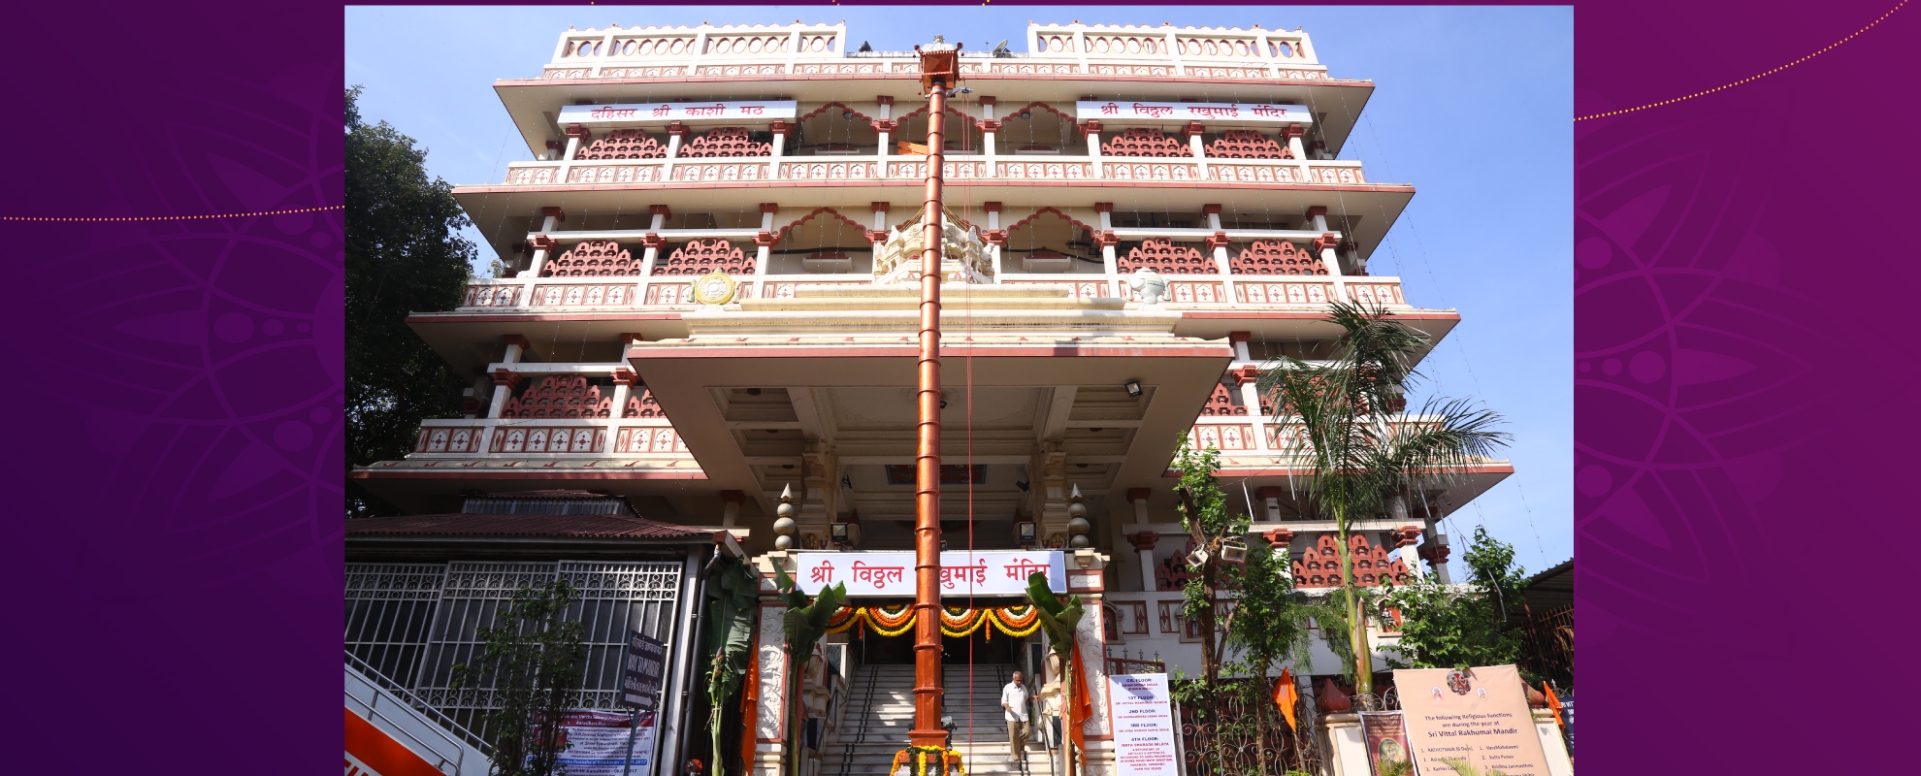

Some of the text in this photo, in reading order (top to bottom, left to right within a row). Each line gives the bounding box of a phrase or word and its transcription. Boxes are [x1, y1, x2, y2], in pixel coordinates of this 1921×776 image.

[591, 103, 765, 120] दहिसर श्री काशी मठ
[1100, 102, 1119, 115] श्री
[1187, 104, 1239, 119] रखुमाई
[1251, 105, 1288, 118] मंदिर
[810, 560, 835, 584] श्री
[852, 560, 904, 589] विठ्ठल
[940, 558, 988, 589] खुमाई
[627, 654, 637, 671] WAY
[644, 658, 660, 678] MANDIR
